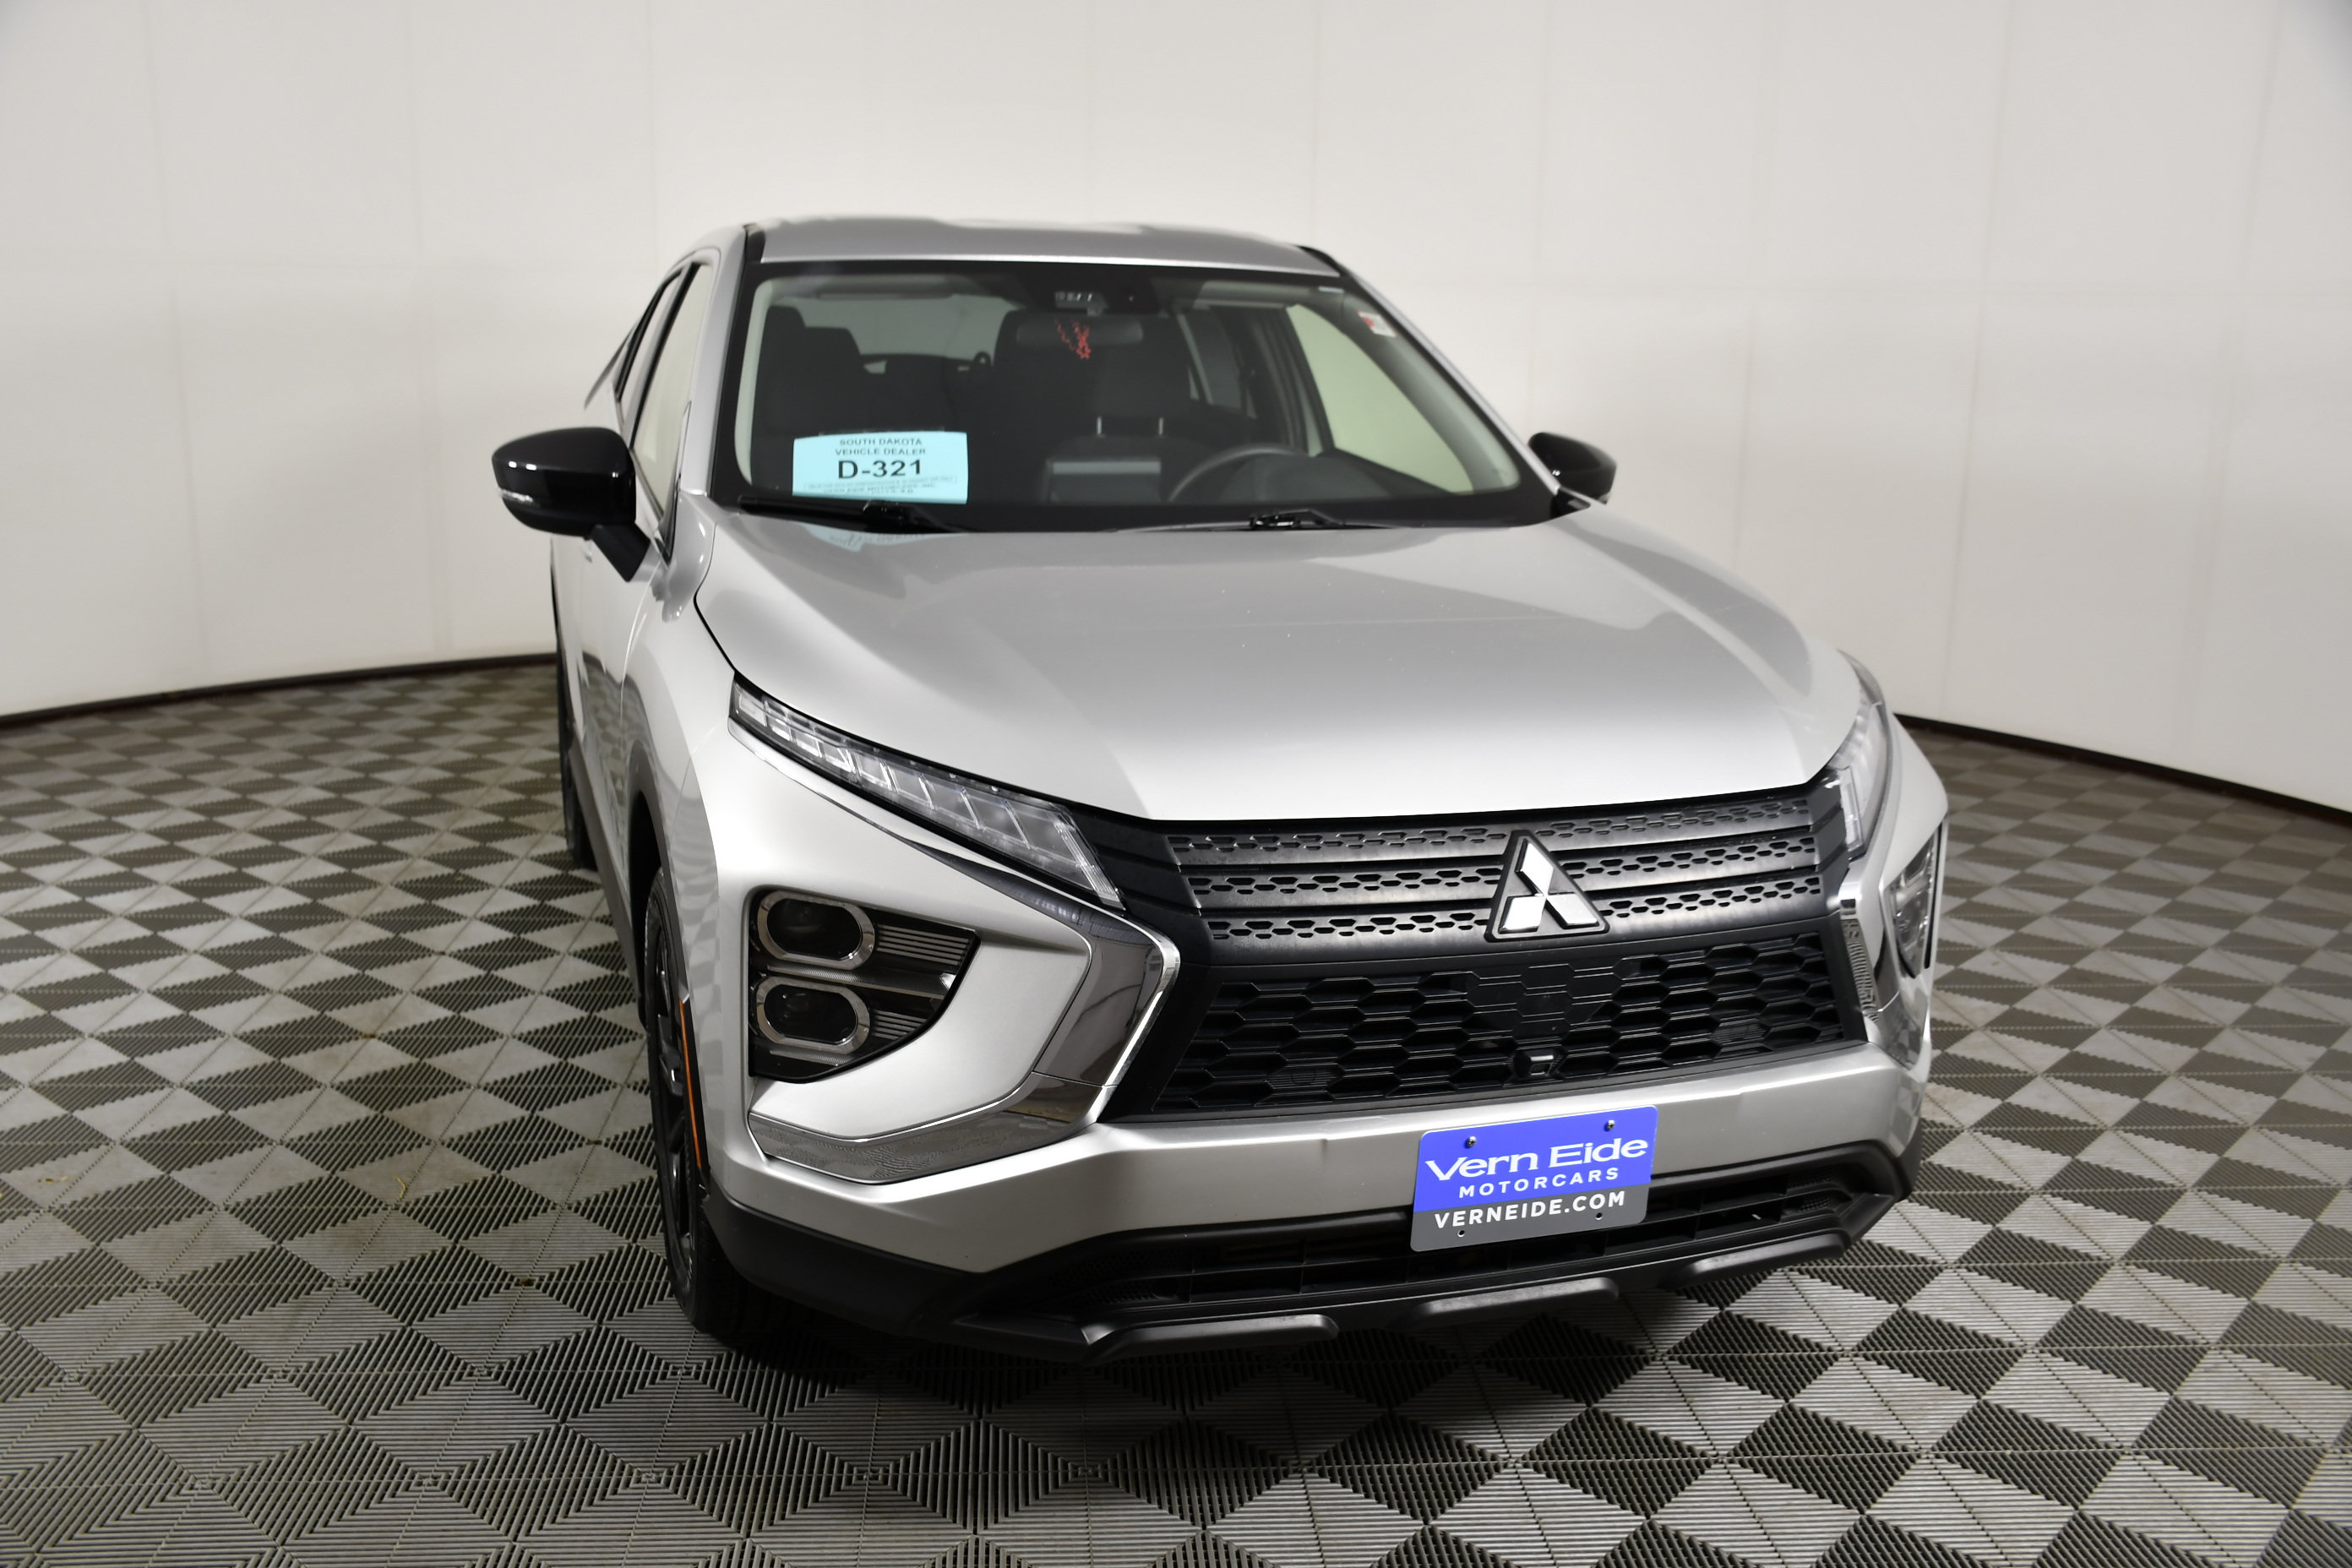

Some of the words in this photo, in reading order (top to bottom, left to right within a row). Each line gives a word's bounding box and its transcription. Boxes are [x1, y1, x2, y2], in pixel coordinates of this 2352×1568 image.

[838, 460, 921, 479] D-321
[1425, 1152, 1538, 1181] Vern
[1549, 1138, 1648, 1168] Eide
[1459, 1168, 1619, 1199] MOTORCARS
[1435, 1190, 1625, 1229] VERNEIDE.COM
